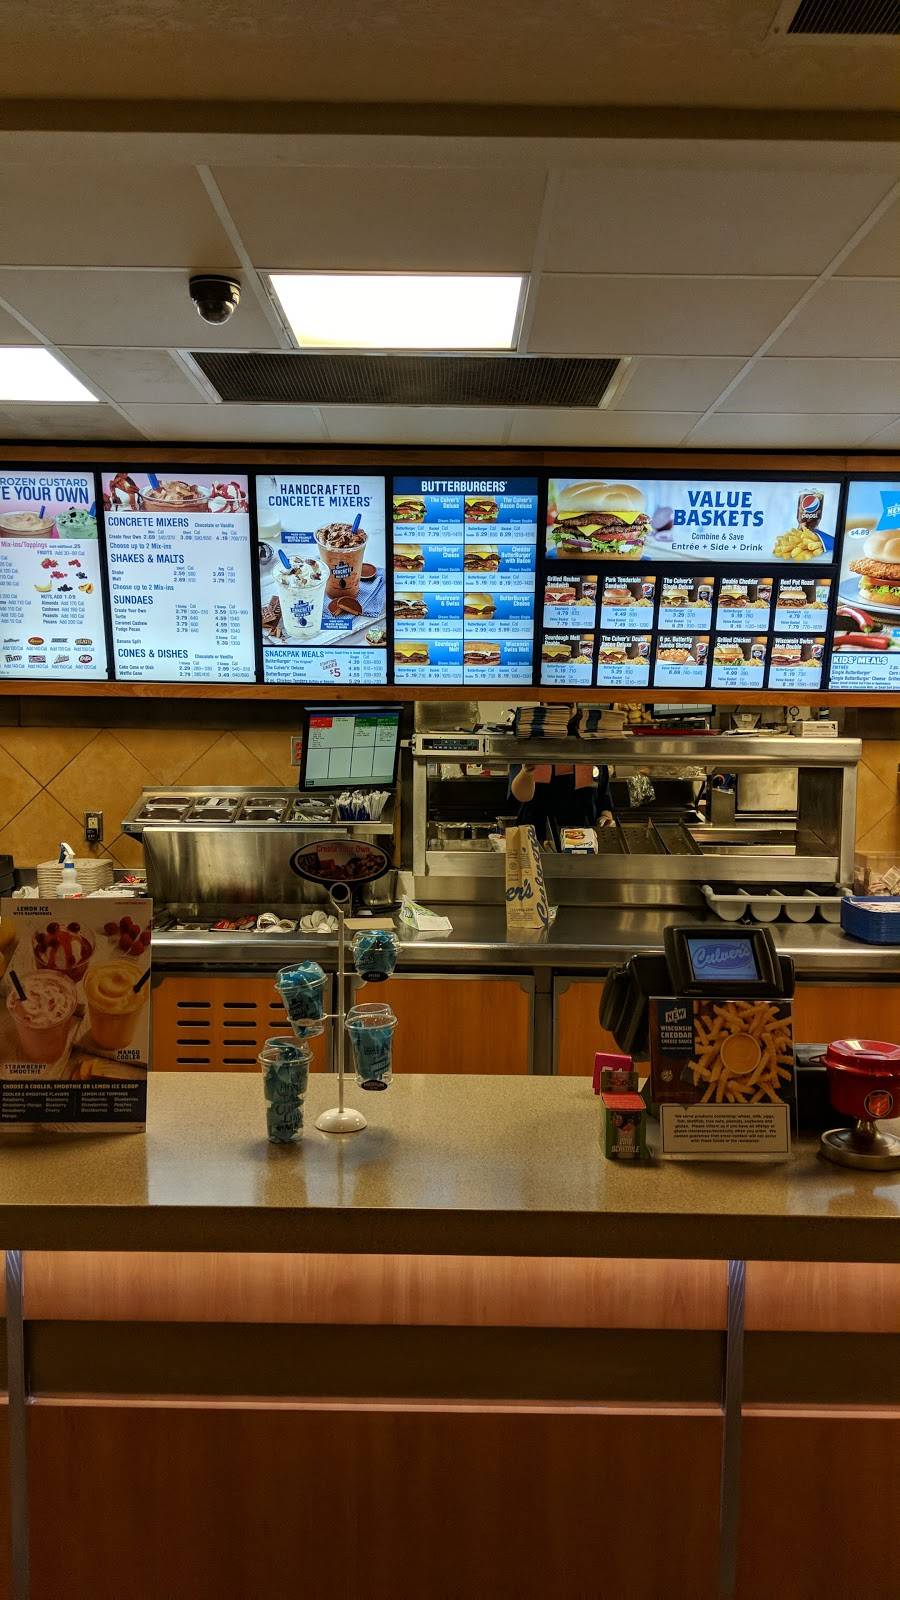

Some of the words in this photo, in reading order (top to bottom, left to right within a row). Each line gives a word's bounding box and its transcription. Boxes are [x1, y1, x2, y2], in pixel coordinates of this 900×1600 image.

[39, 478, 88, 487] CUSTARD
[280, 484, 361, 495] HANDCRAFTED
[0, 486, 10, 500] E
[14, 486, 51, 501] YOUR
[55, 487, 89, 504] OWN
[687, 490, 753, 508] VALUE
[268, 496, 326, 507] CONCRETE
[673, 509, 764, 527] BASKETS
[801, 512, 818, 521] pepsi
[108, 516, 154, 527] CONCRETE
[156, 517, 189, 528] MIXERS
[691, 532, 720, 541] Combine
[721, 533, 727, 541] &
[728, 533, 745, 541] Save
[671, 542, 699, 551] Entrée
[710, 543, 729, 551] Side
[739, 543, 763, 552] Drink
[110, 553, 145, 563] SHAKES
[147, 554, 153, 563] &
[156, 554, 185, 564] MALTS
[546, 575, 563, 583] Grilled
[617, 576, 642, 584] Tenderloin
[739, 578, 759, 586] Cheddar
[801, 579, 815, 587] Roast
[604, 582, 628, 590] Sandwich
[662, 583, 675, 591] Single
[675, 583, 694, 591] Deluxe
[779, 585, 803, 593] Sandwich
[113, 594, 154, 605] SUNDAES
[544, 633, 570, 642] Sourdough
[631, 635, 648, 643] Double
[716, 636, 731, 644] Grilled
[732, 637, 752, 645] Chicken
[775, 637, 798, 645] Wisconsin
[799, 637, 814, 645] Swiss
[613, 641, 632, 649] Deluxe
[118, 648, 146, 658] CONES
[148, 649, 155, 658] &
[157, 649, 189, 659] DISHES
[264, 650, 300, 658] SNACKPAK
[301, 651, 325, 659] MEALS
[832, 656, 857, 665] KIDS'
[857, 656, 888, 666] MEALS
[329, 667, 341, 678] $5
[693, 942, 752, 969] Culver's
[665, 1007, 687, 1023] NEW
[660, 1031, 693, 1039] CHEDDAR
[29, 1083, 53, 1091] COOLER,
